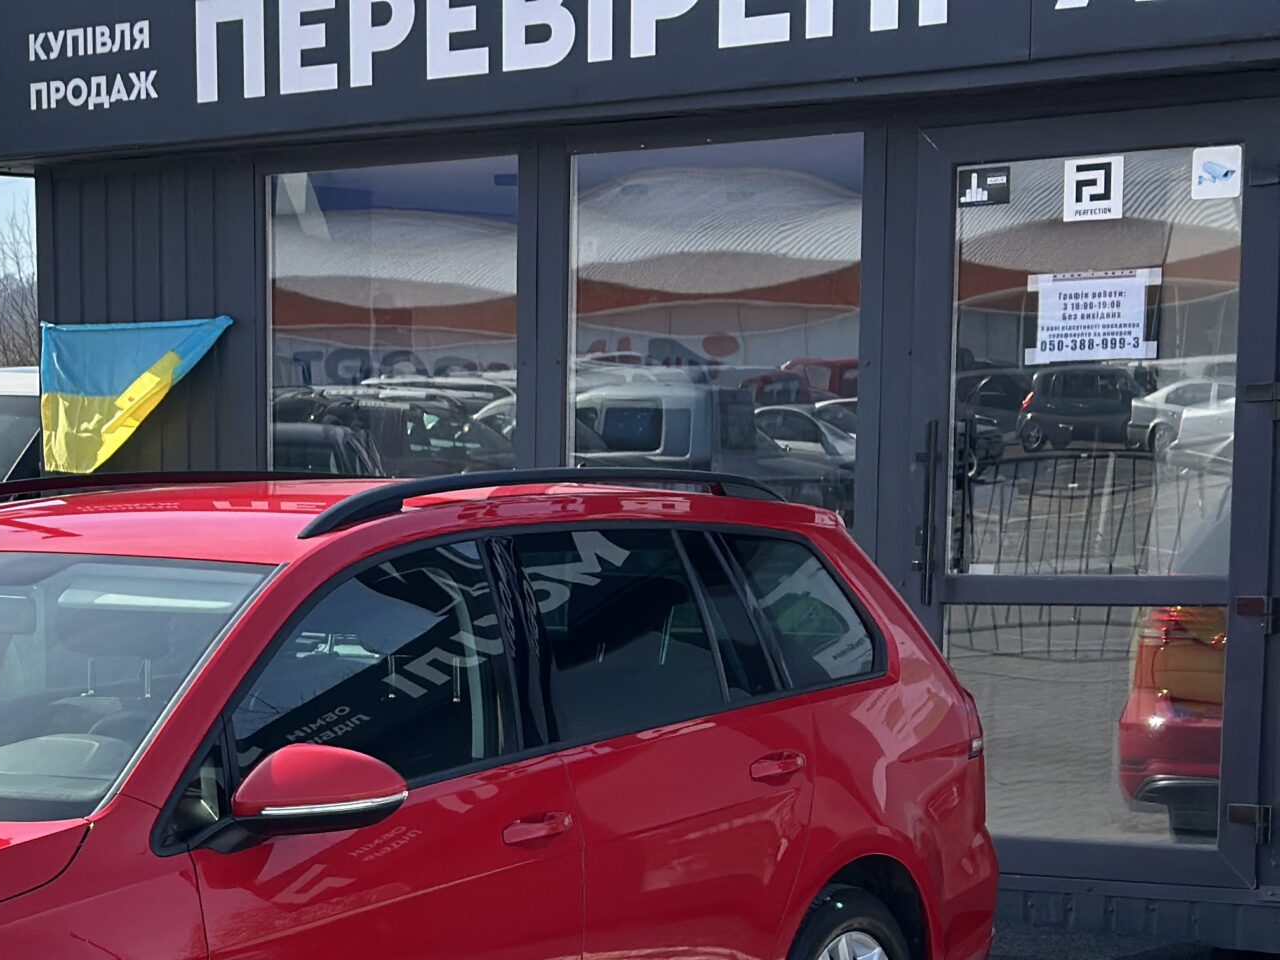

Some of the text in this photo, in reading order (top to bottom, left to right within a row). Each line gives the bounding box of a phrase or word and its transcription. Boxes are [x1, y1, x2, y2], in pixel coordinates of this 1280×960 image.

[28, 19, 150, 62] КУПІВЛЯ
[29, 69, 159, 111] ПРОДАЖ
[1074, 207, 1112, 217] PERFECTION
[1040, 336, 1140, 353] 050-388-999-3
